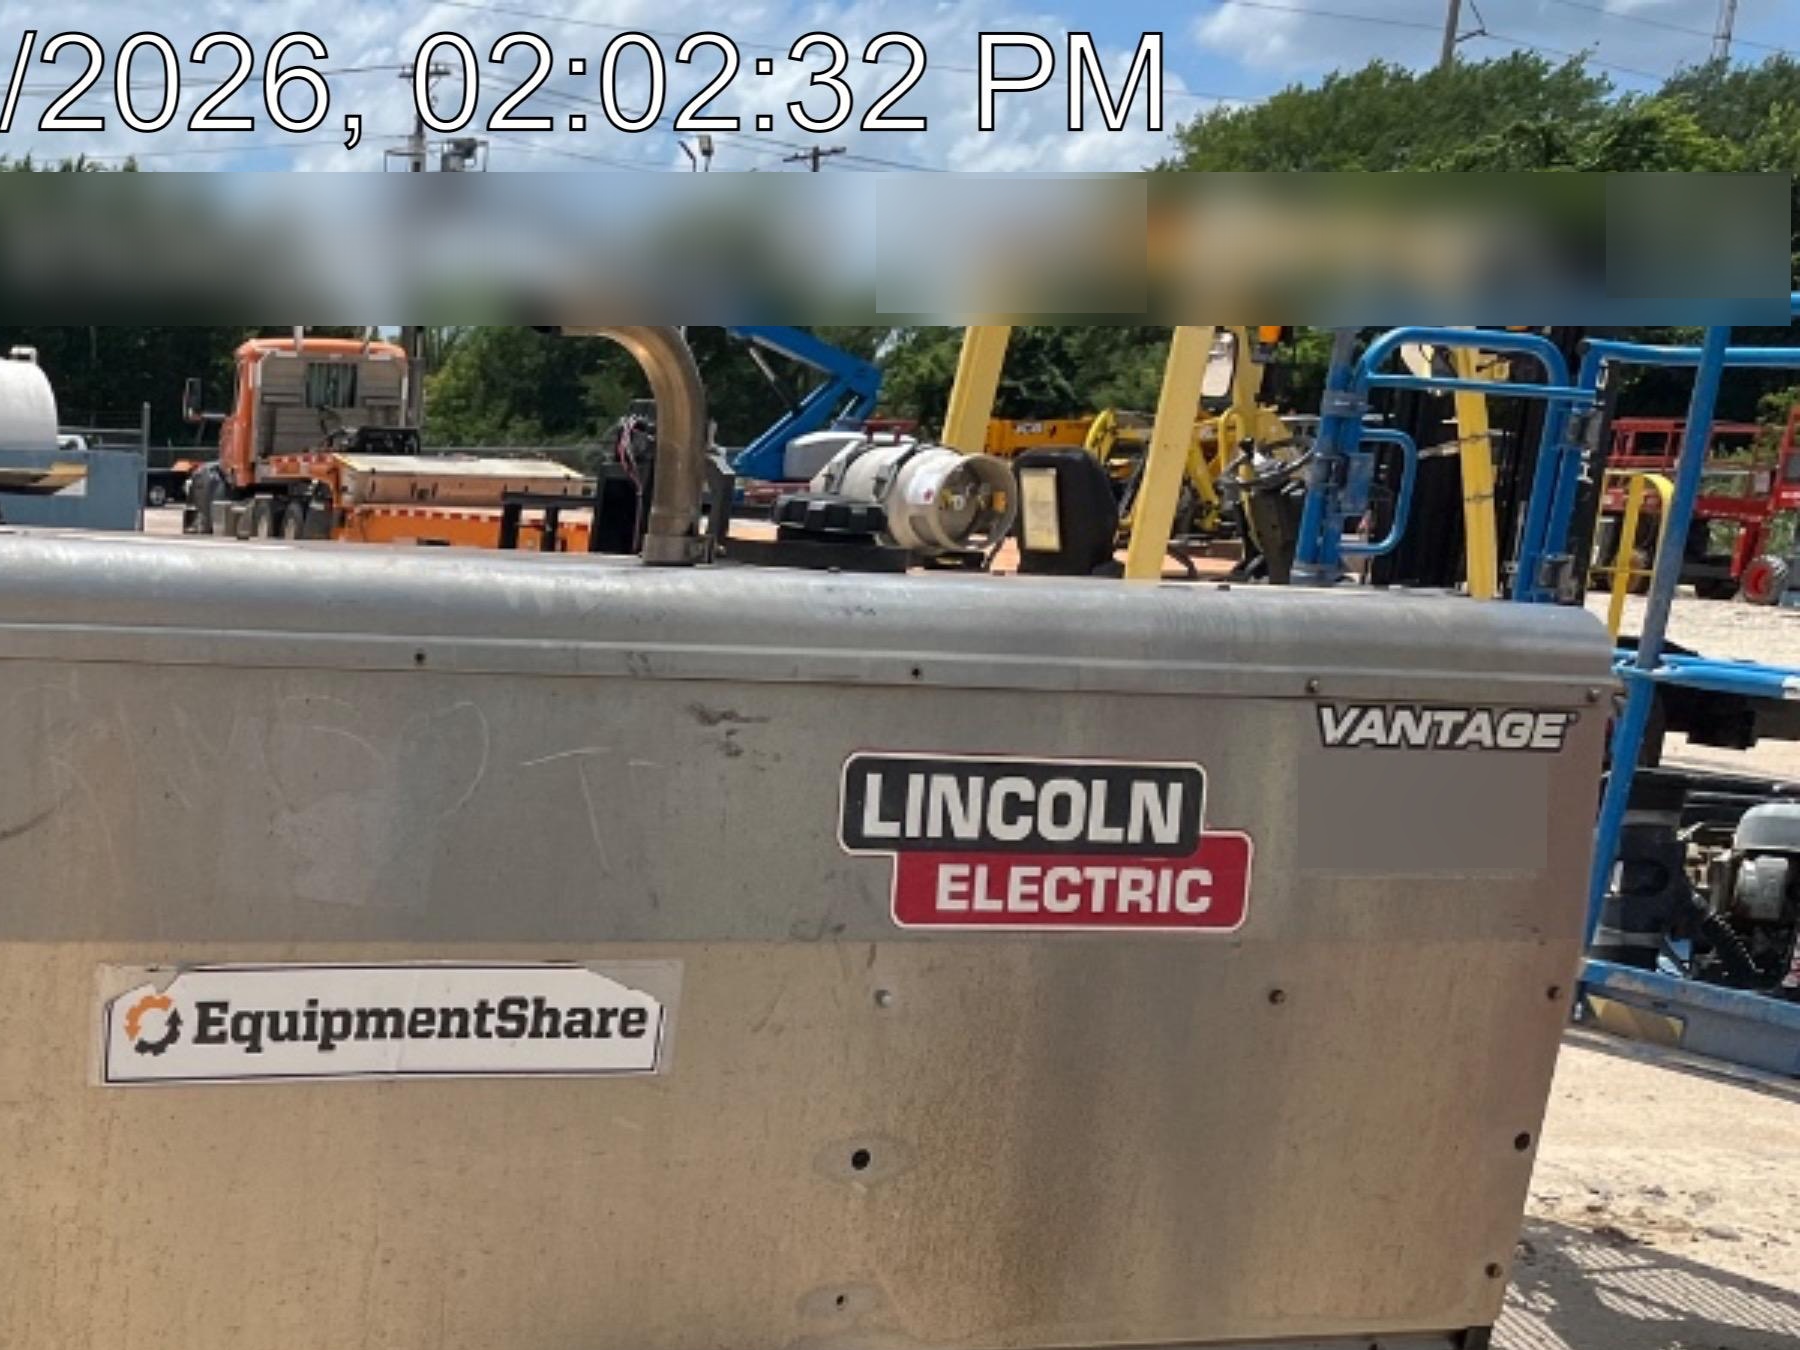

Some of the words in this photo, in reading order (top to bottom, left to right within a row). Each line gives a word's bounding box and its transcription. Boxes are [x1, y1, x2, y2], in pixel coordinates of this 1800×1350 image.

[1318, 703, 1569, 752] VANTAGE
[862, 772, 1183, 845] LINCOLN
[935, 863, 1213, 914] ELECTRIC
[193, 995, 648, 1054] EquipmentShare
